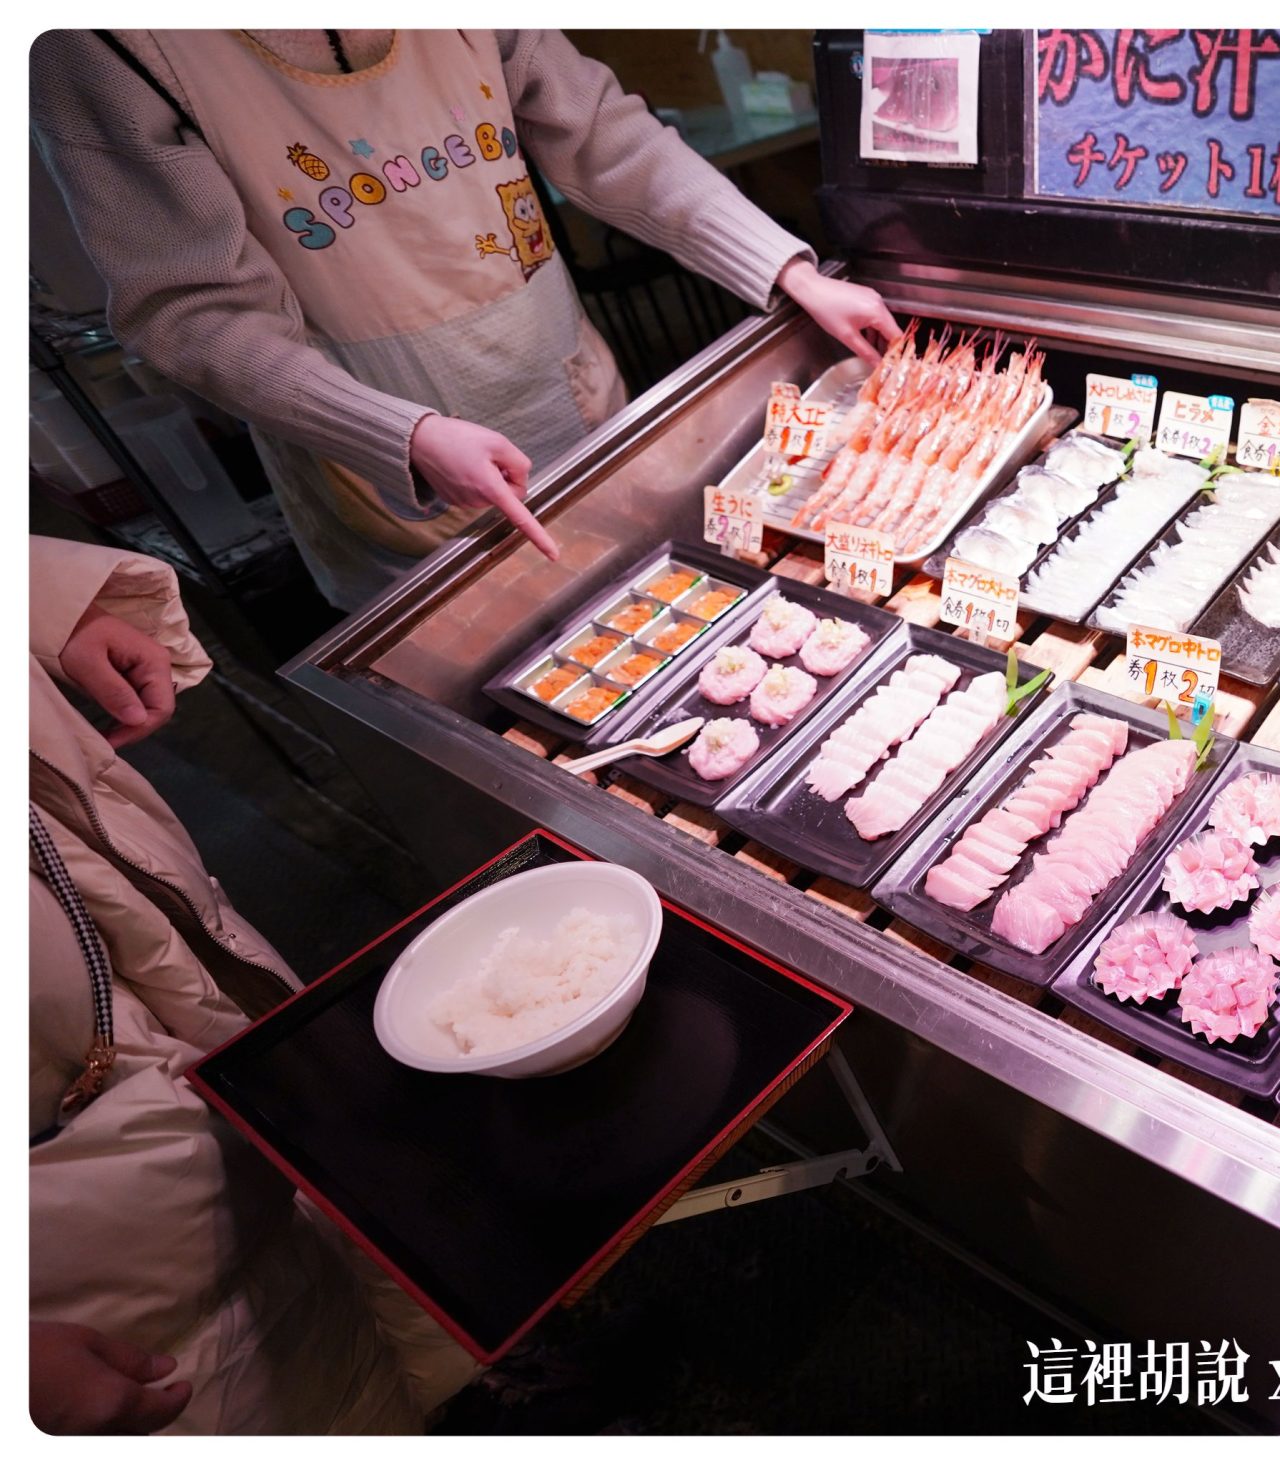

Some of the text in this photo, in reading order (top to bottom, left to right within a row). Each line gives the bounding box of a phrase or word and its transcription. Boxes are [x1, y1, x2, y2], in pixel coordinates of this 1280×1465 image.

[1175, 400, 1214, 423] ヒラメ
[712, 492, 752, 517] 生うに
[1130, 629, 1221, 662] 本マグロ中トロ
